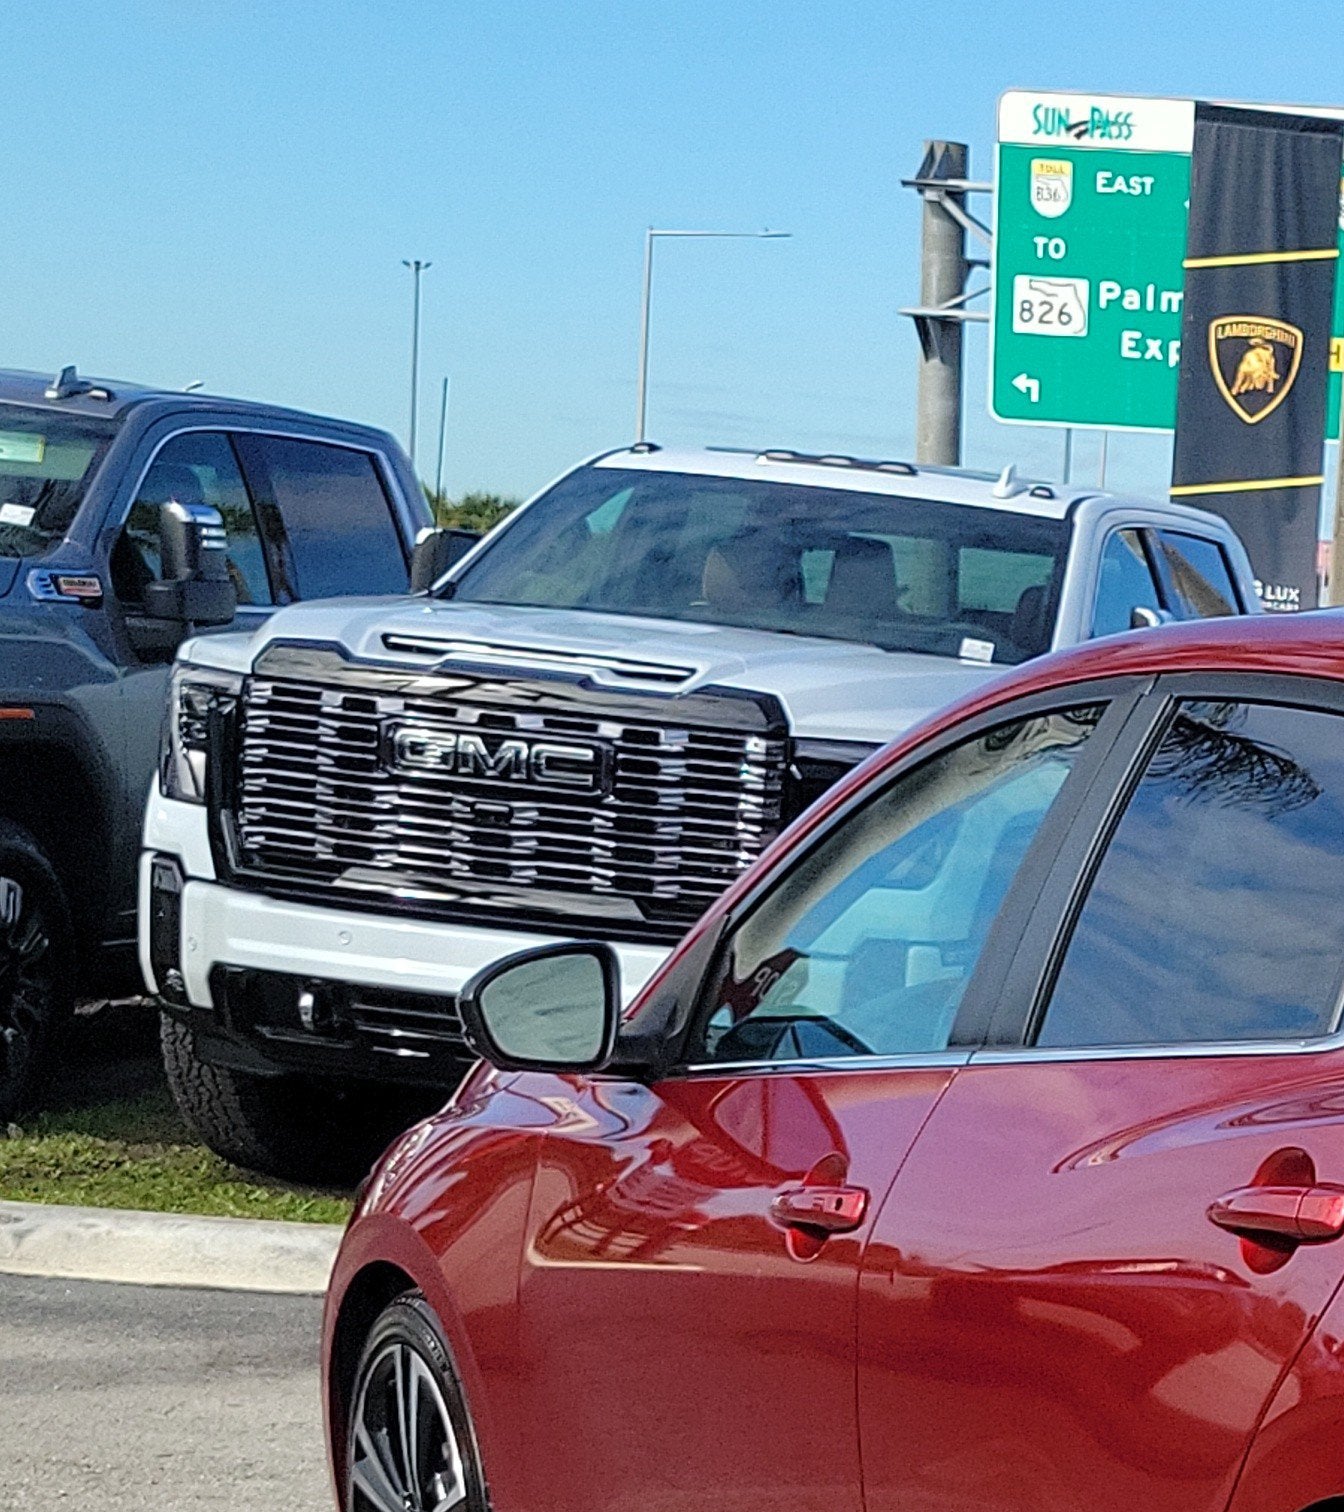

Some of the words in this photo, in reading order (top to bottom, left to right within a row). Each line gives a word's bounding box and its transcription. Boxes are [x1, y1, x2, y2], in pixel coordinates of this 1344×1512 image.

[1036, 186, 1061, 202] 836
[1096, 171, 1155, 196] EAST
[1033, 236, 1066, 260] TO
[1019, 299, 1073, 326] 826
[393, 727, 595, 787] GMC
